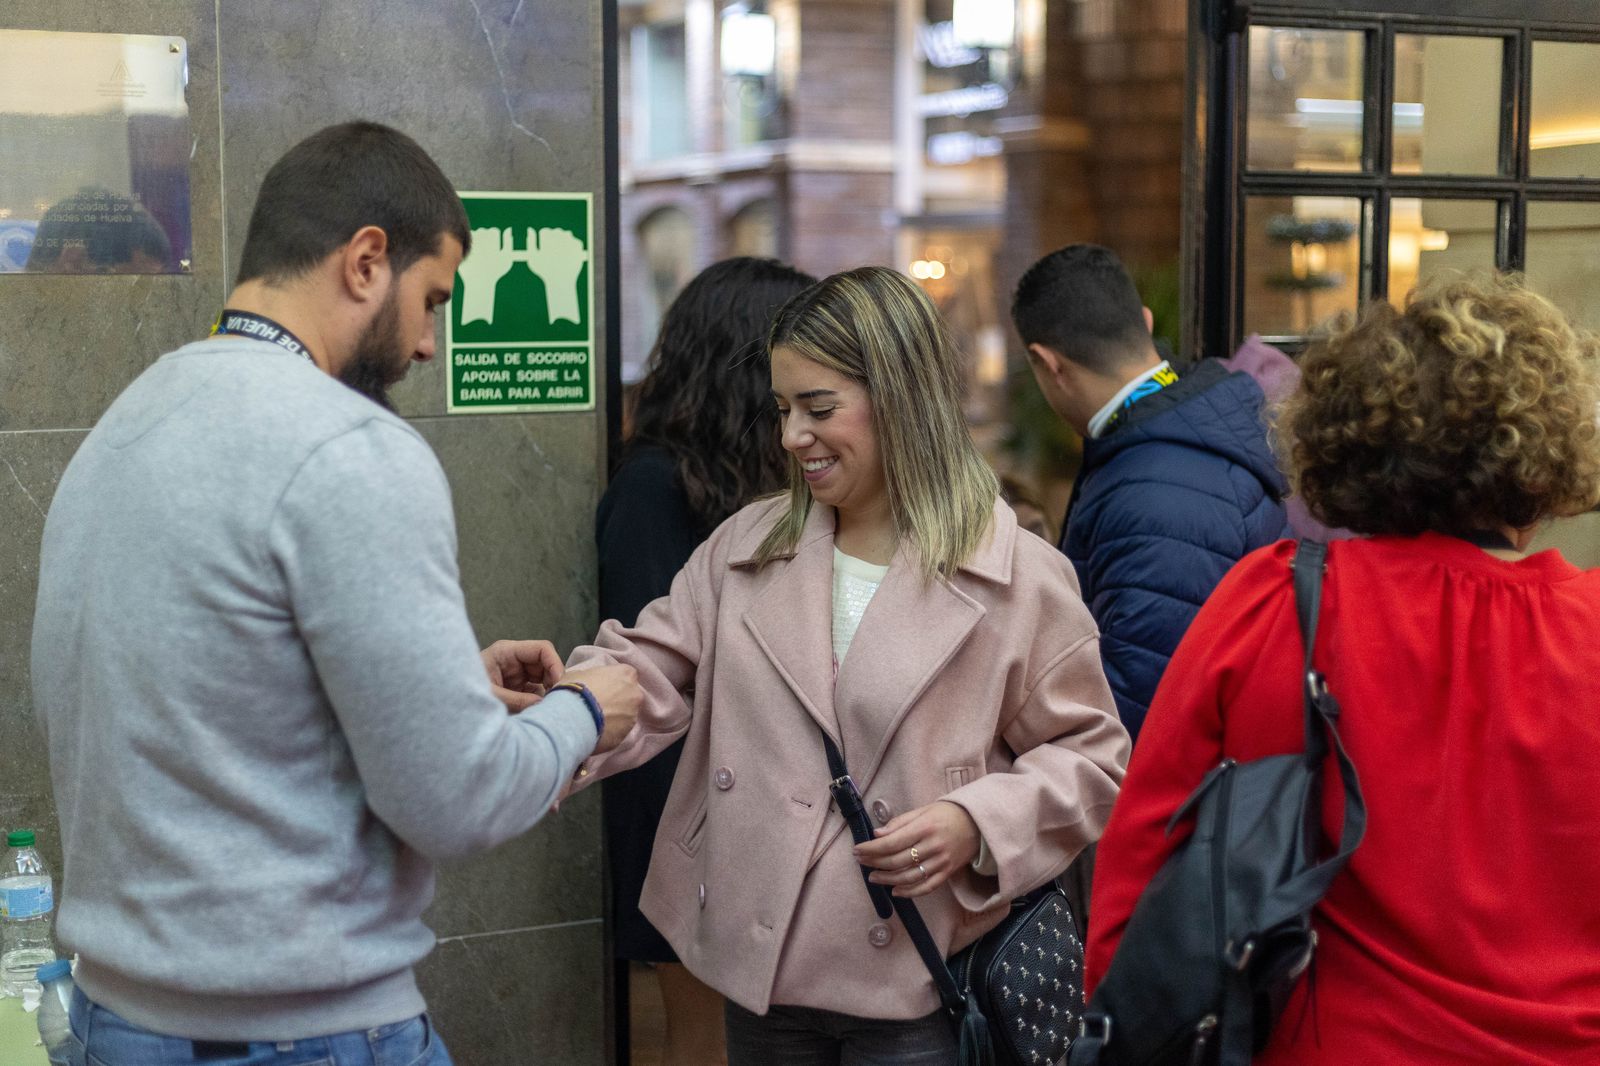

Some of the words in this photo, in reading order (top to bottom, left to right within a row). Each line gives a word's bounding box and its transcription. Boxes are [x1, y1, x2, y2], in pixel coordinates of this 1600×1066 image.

[100, 213, 133, 223] Huelva
[226, 316, 280, 340] HUELVA
[276, 334, 301, 353] DE
[454, 353, 499, 366] SALIDA
[503, 352, 521, 365] DE
[526, 351, 587, 365] SOCORRO
[461, 370, 511, 383] APOYAR
[516, 369, 559, 382] SOBRE
[563, 369, 580, 381] LA
[460, 388, 503, 401] BARRA
[507, 387, 541, 400] PARA
[546, 386, 584, 398] ABRIR
